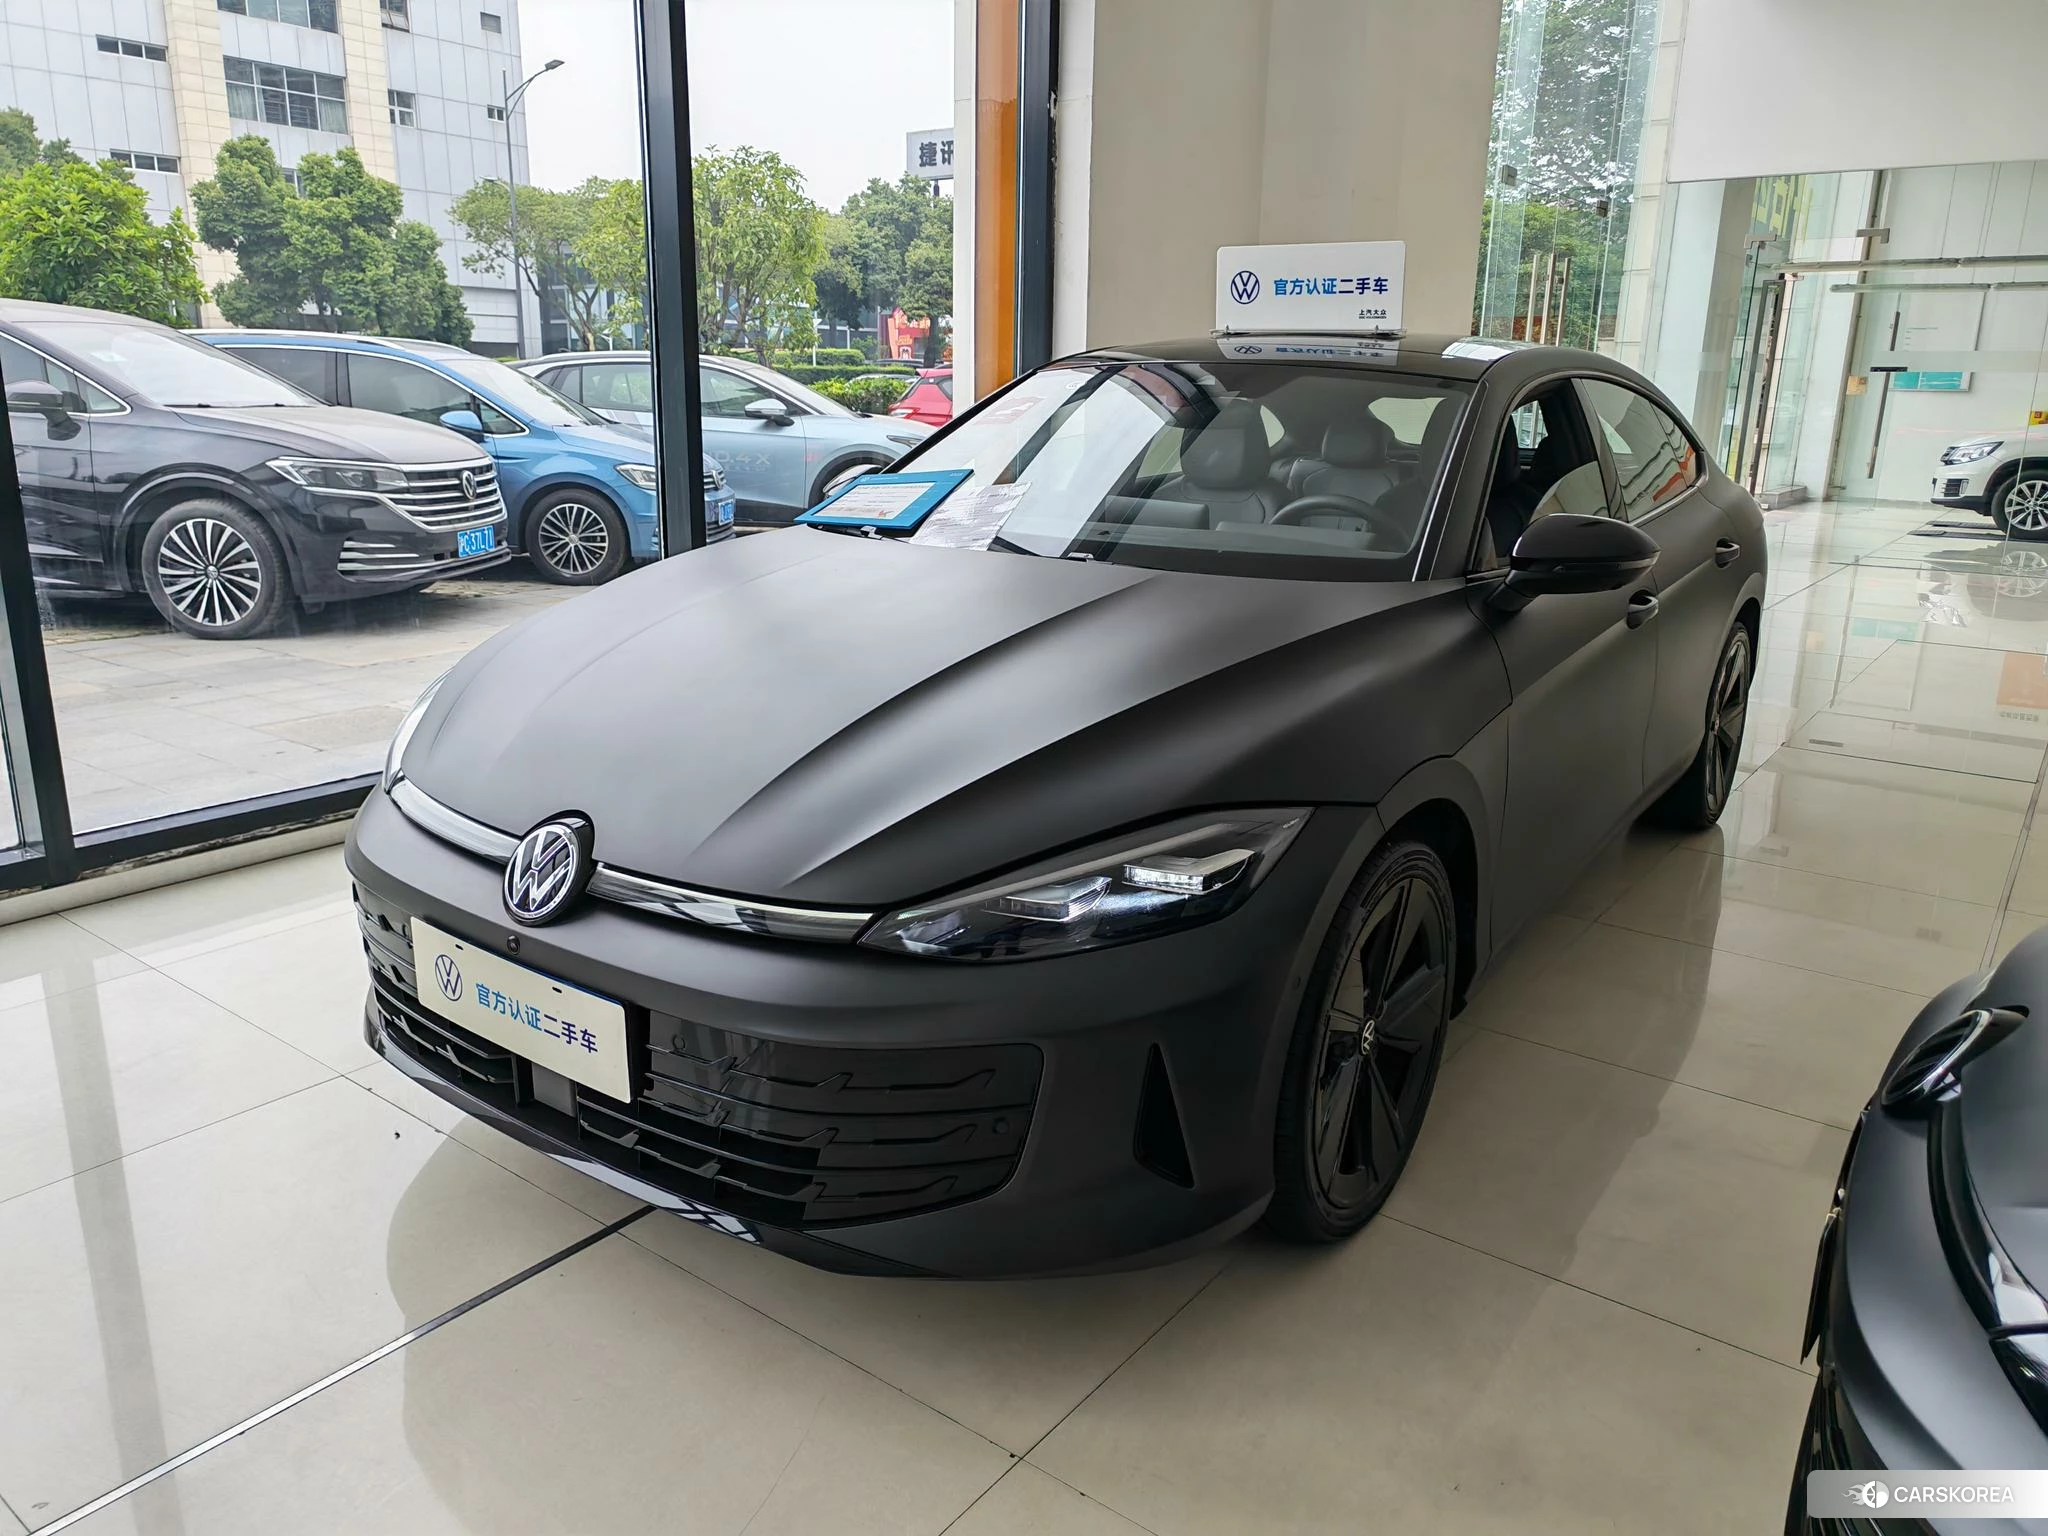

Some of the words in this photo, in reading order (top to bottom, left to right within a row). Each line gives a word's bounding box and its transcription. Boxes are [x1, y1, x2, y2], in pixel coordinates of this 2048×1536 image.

[1273, 277, 1389, 296] 官方认证二手车
[475, 983, 599, 1054] 官方认证二手车
